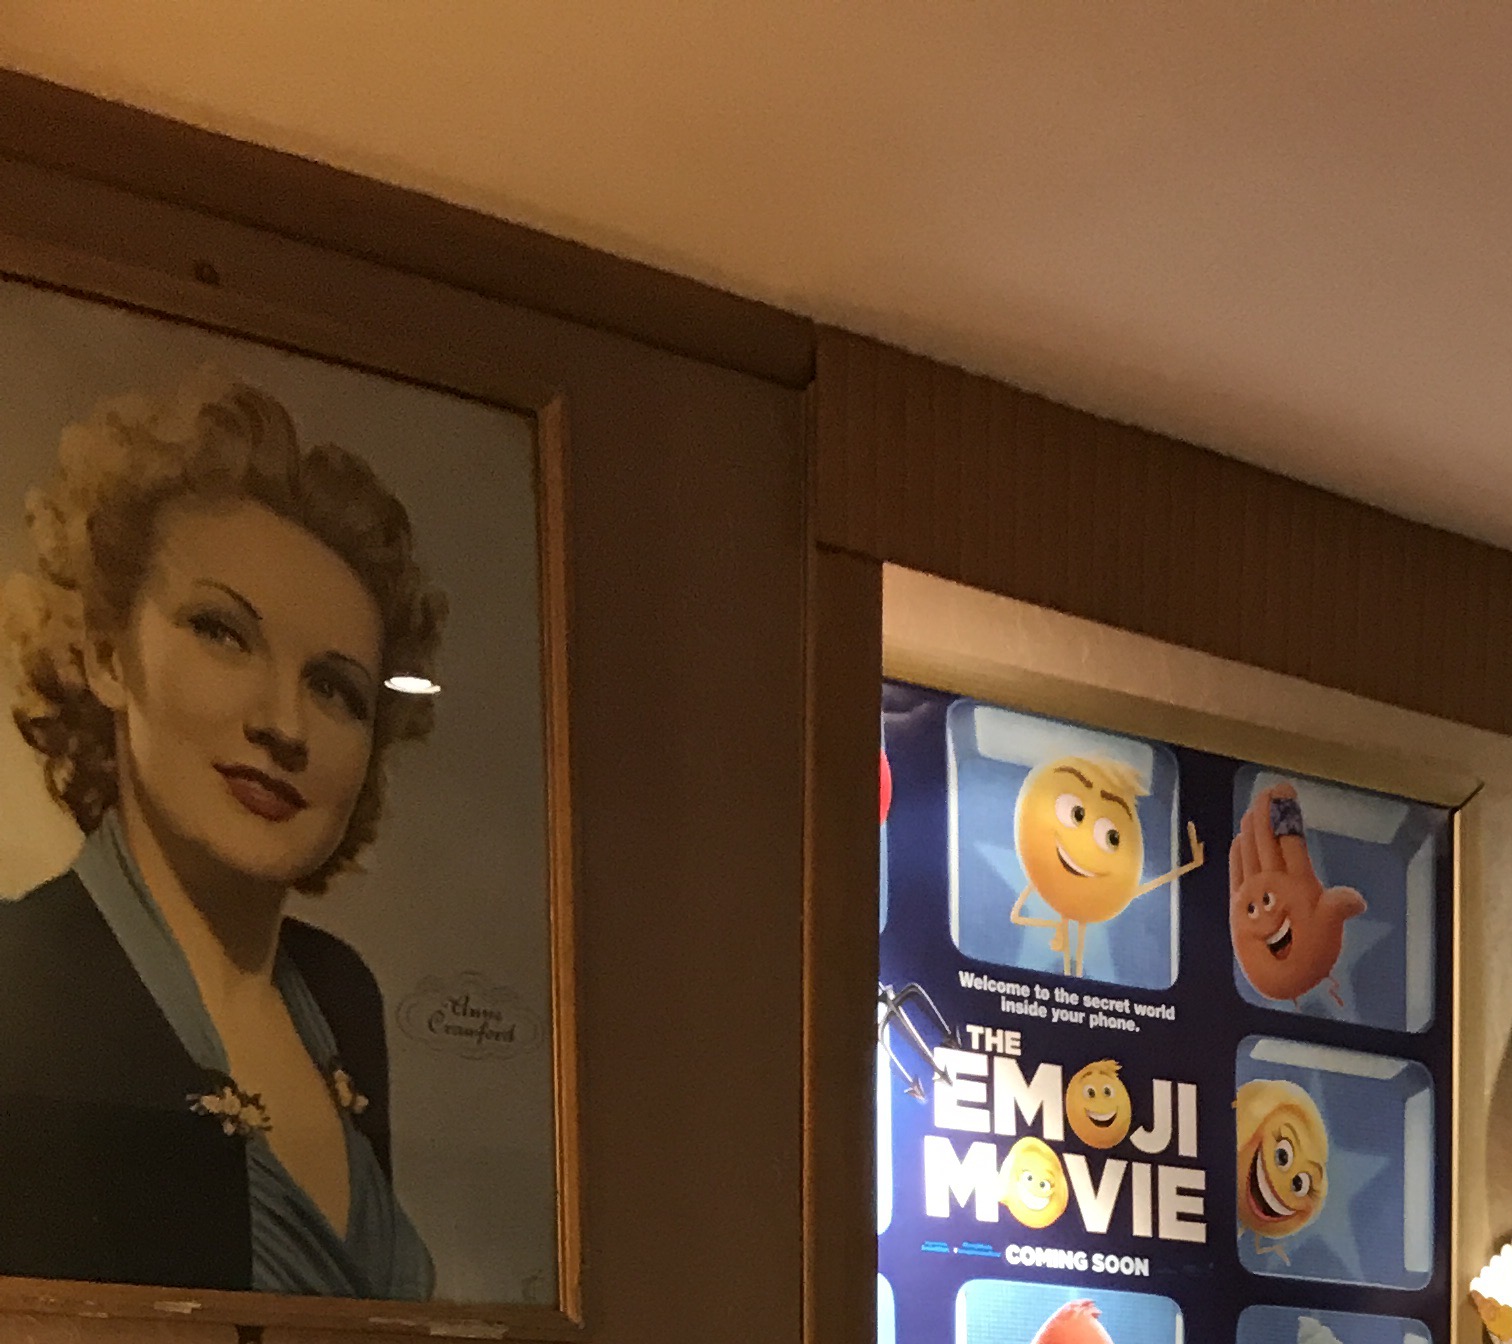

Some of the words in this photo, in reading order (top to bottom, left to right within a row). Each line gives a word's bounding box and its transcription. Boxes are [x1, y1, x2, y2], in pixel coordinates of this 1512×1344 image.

[958, 970, 1031, 999] Welcome
[1034, 983, 1050, 1001] to
[1053, 987, 1080, 1006] the
[1083, 993, 1131, 1015] secret
[1134, 1001, 1176, 1021] world
[1000, 996, 1048, 1019] inside
[1051, 1006, 1086, 1025] your
[1089, 1011, 1140, 1032] phone.
[966, 1024, 1022, 1057] THE
[1005, 1244, 1088, 1272] COMING
[1091, 1253, 1150, 1277] SOON
